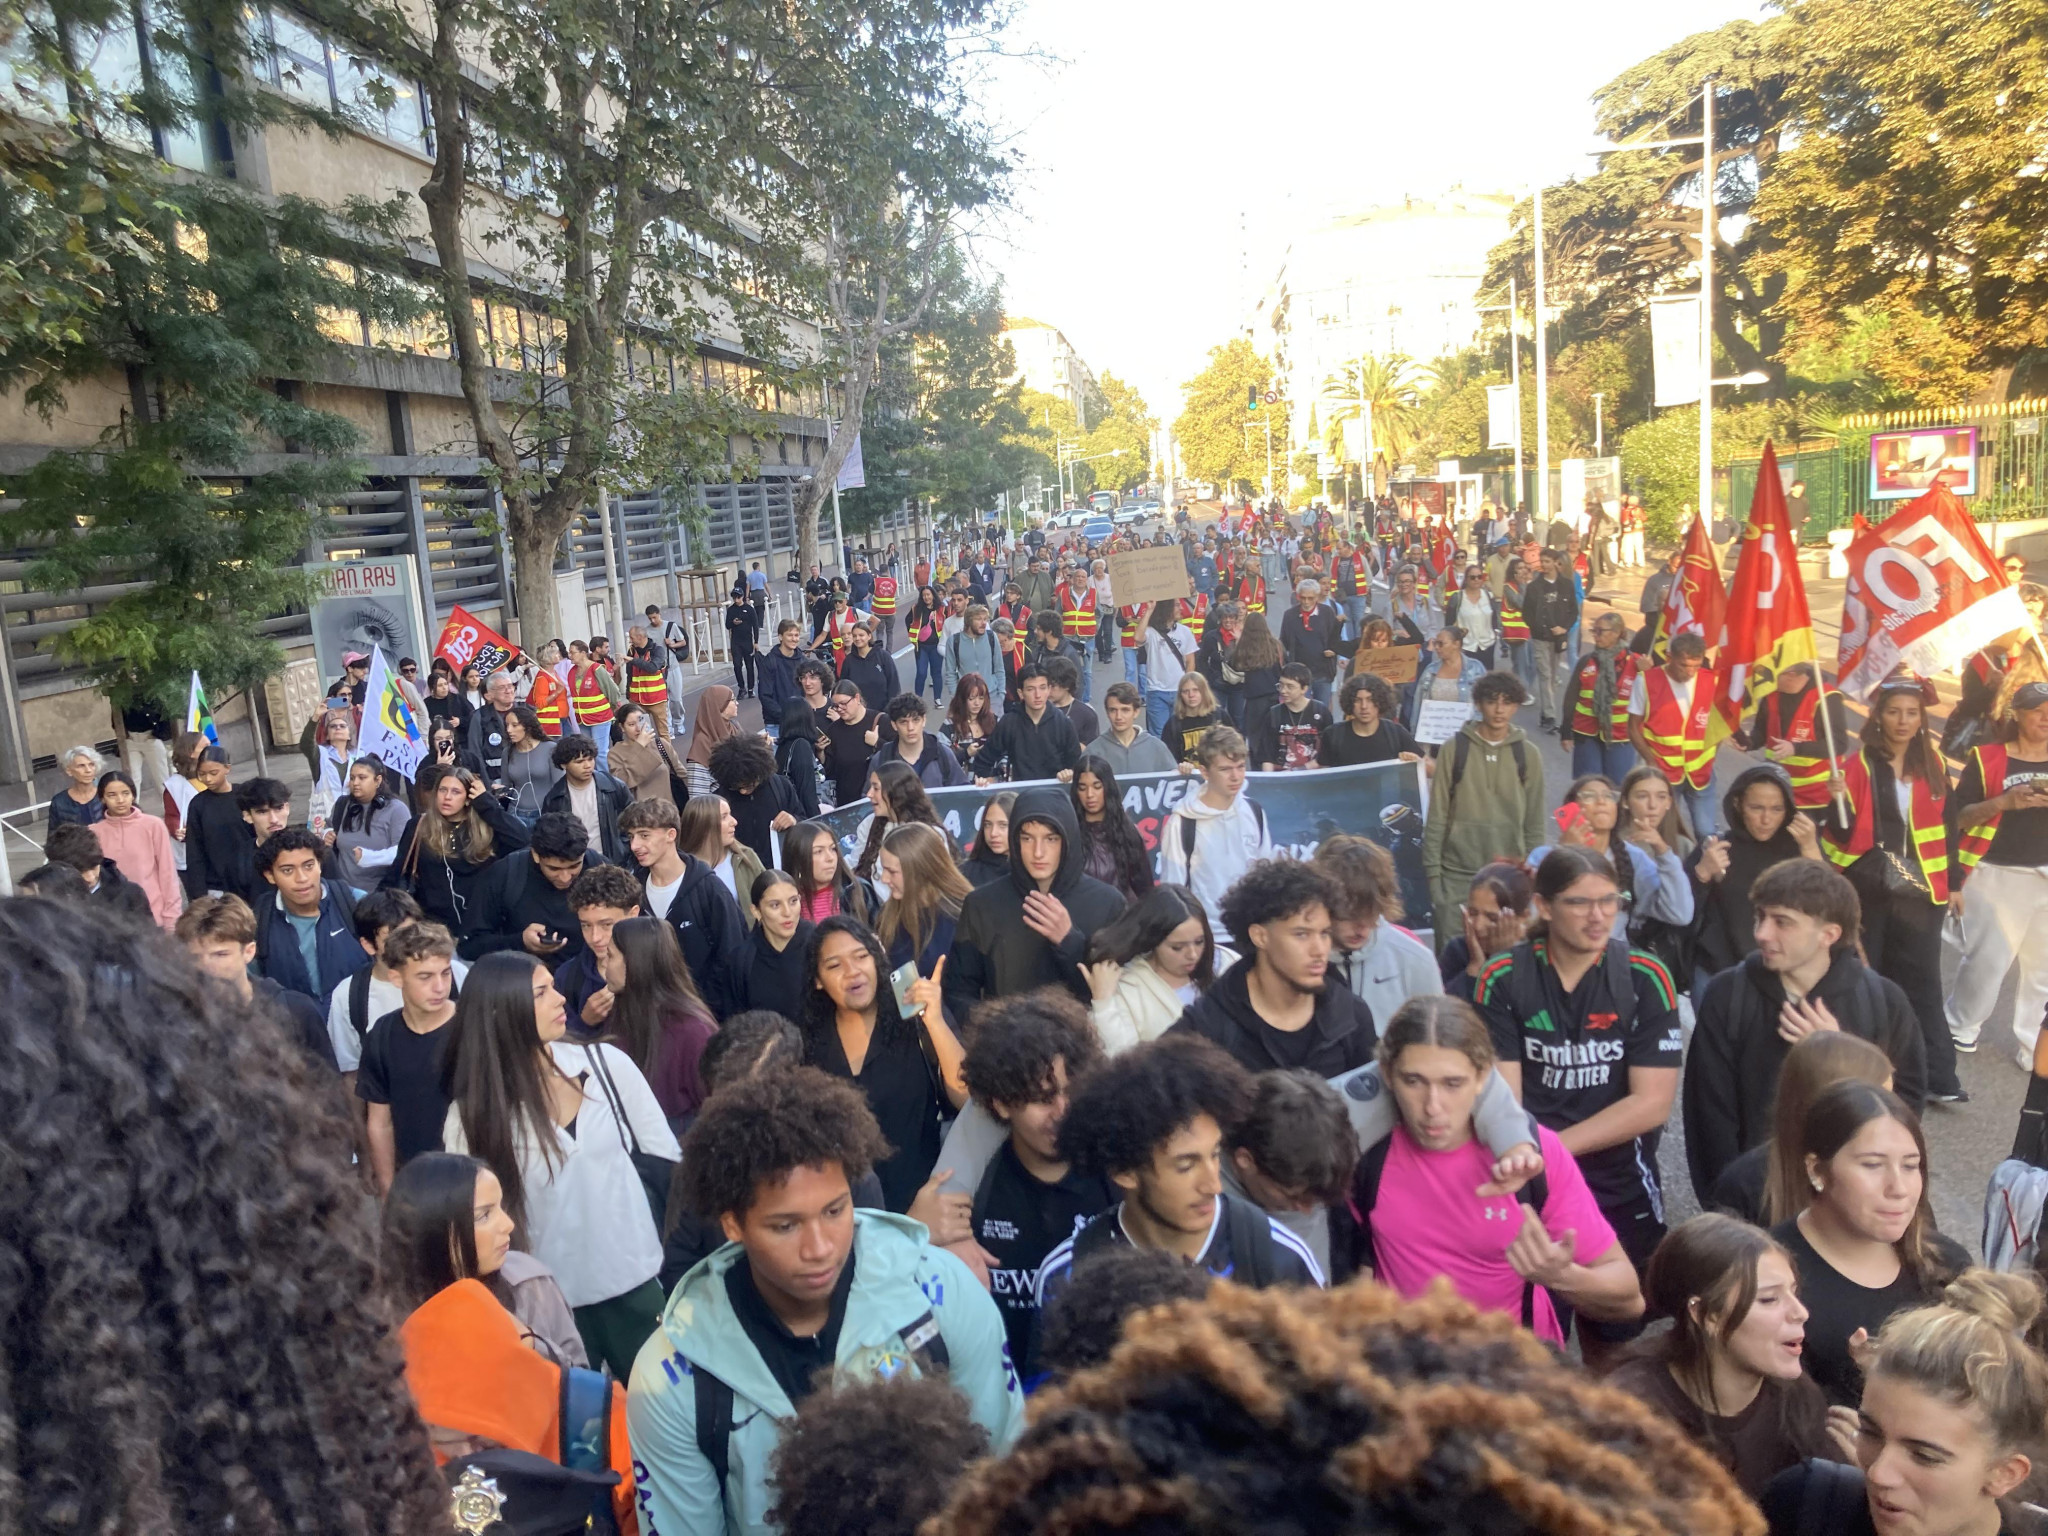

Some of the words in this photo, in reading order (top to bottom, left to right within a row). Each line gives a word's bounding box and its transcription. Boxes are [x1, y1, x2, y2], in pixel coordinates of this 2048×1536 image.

[362, 565, 396, 588] RAY
[383, 749, 414, 776] PAC
[1524, 1036, 1624, 1067] Emirates
[1542, 1065, 1564, 1089] FLY
[989, 1268, 1041, 1295] EW
[1007, 1299, 1036, 1309] MAN
